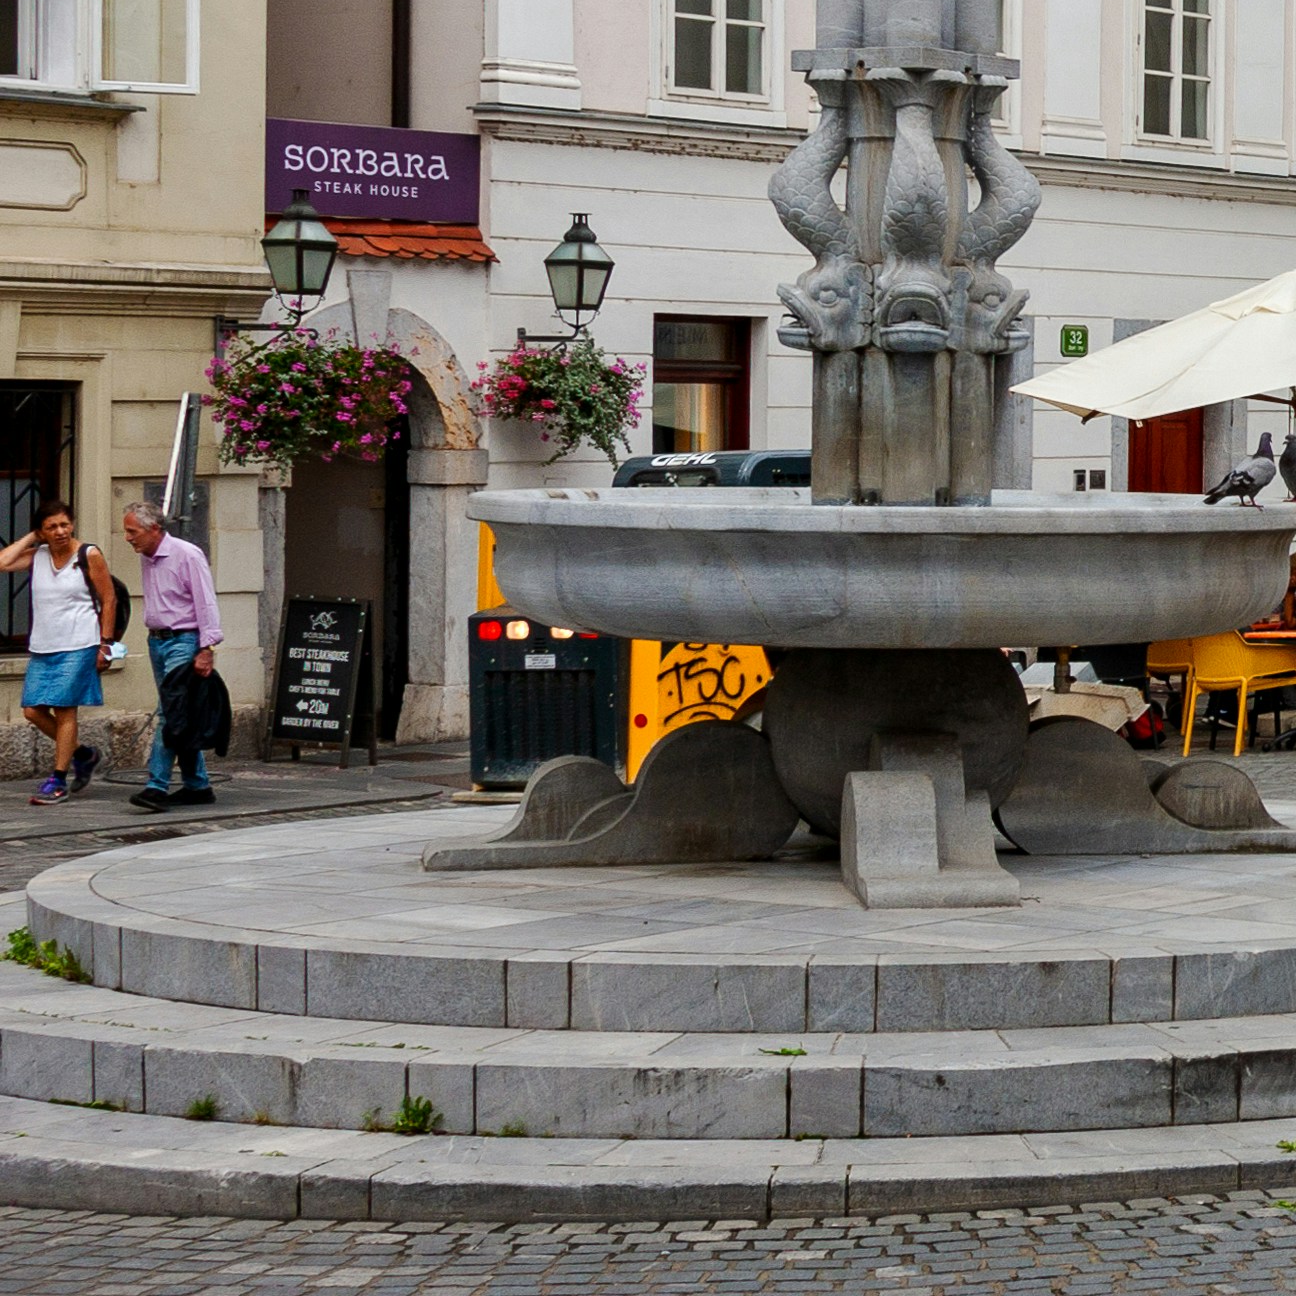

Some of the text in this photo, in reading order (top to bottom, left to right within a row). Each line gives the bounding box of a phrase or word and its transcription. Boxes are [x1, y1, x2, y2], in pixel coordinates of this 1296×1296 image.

[284, 144, 450, 180] SORBARA
[314, 181, 419, 198] STEAK HOUSE
[1069, 330, 1083, 345] 32
[651, 452, 717, 467] GEHL
